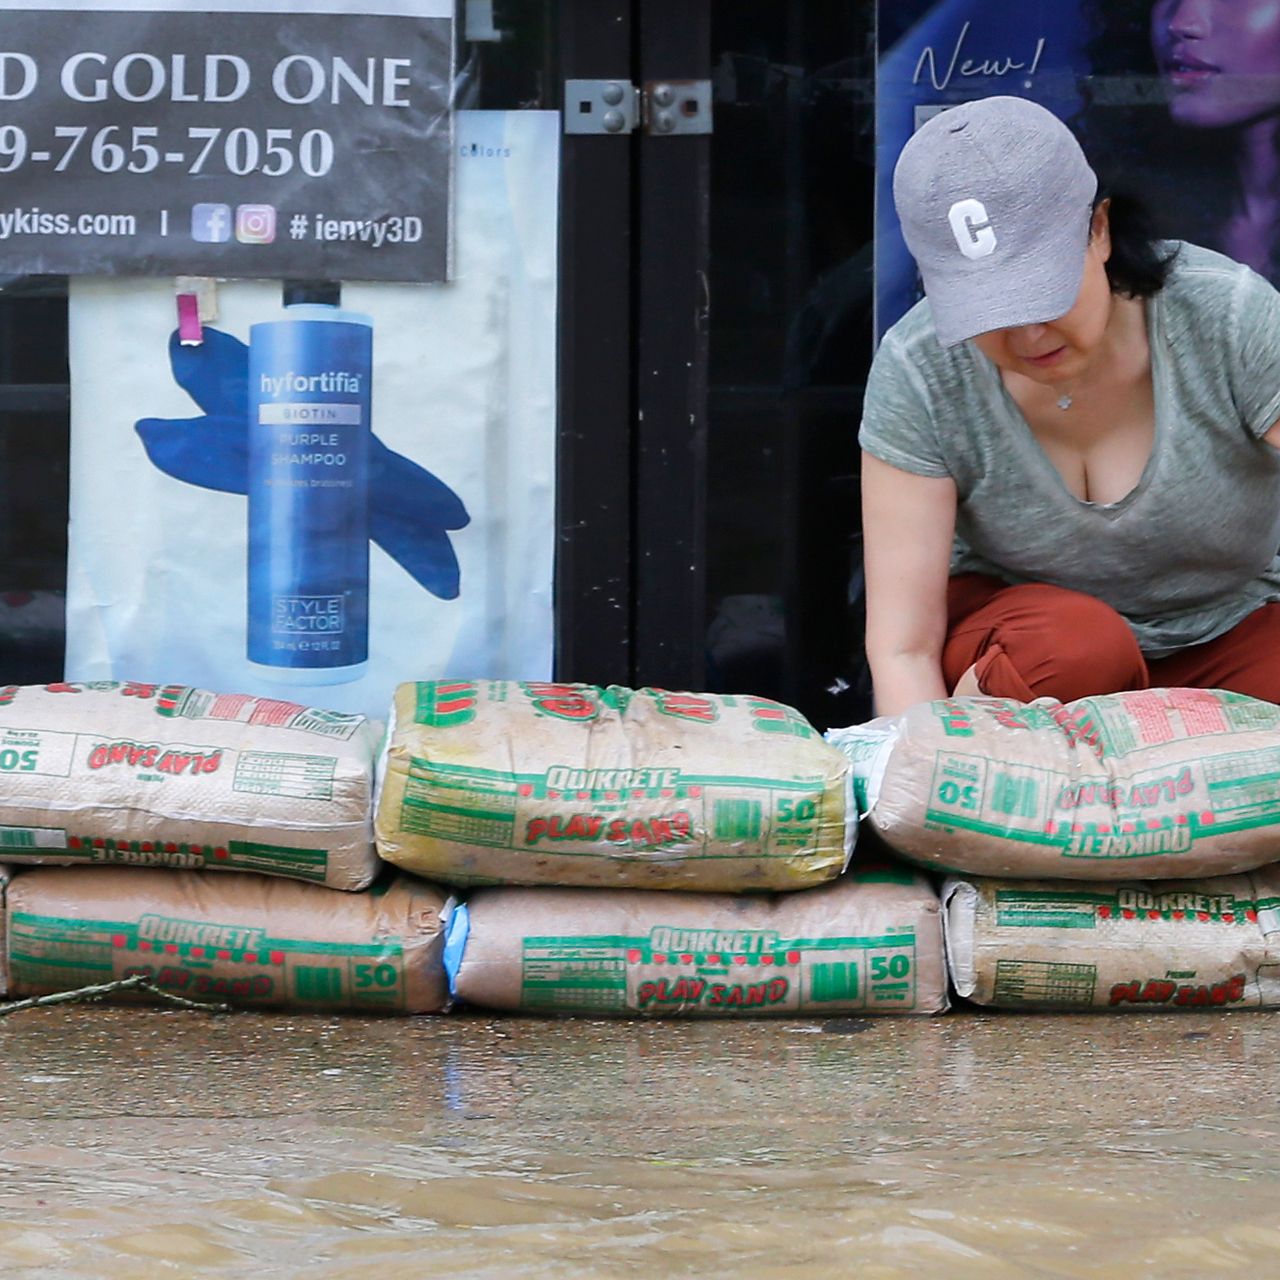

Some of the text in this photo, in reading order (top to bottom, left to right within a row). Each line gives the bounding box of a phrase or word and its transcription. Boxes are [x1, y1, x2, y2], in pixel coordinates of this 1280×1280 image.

[913, 20, 1046, 92] New!
[59, 52, 251, 104] GOLD
[272, 55, 412, 108] ONE
[314, 213, 424, 248] ienvy3D
[947, 198, 997, 261] C
[260, 371, 360, 396] hyfortifia
[282, 408, 337, 420] BIOTIN
[279, 433, 339, 446] PURPLE
[270, 452, 347, 466] SHAMPOO
[274, 598, 339, 615] STYLE
[274, 615, 342, 631] FACTOR
[545, 765, 681, 791] QUIKRETE
[937, 780, 982, 809] 50
[775, 797, 816, 823] 50
[525, 810, 694, 848] PLAY SAND
[649, 926, 778, 955] QUIKRETE
[353, 963, 398, 989] 50
[870, 953, 910, 980] 50
[636, 977, 789, 1009] PLAY SAND
